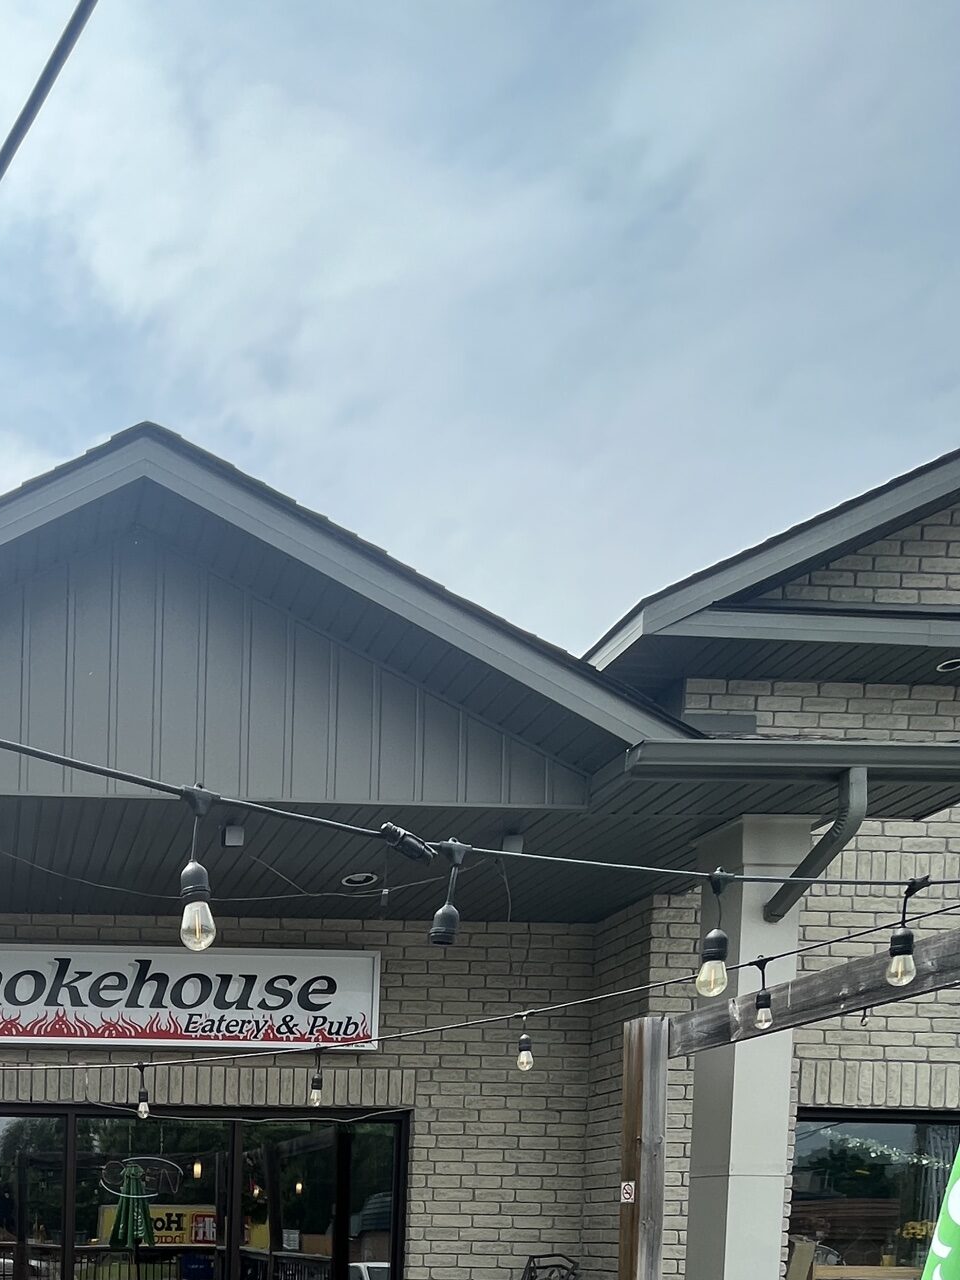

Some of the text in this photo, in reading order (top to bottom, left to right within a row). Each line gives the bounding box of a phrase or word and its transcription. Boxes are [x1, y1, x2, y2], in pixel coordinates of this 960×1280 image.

[184, 1013, 360, 1040] Eatery & Pub
